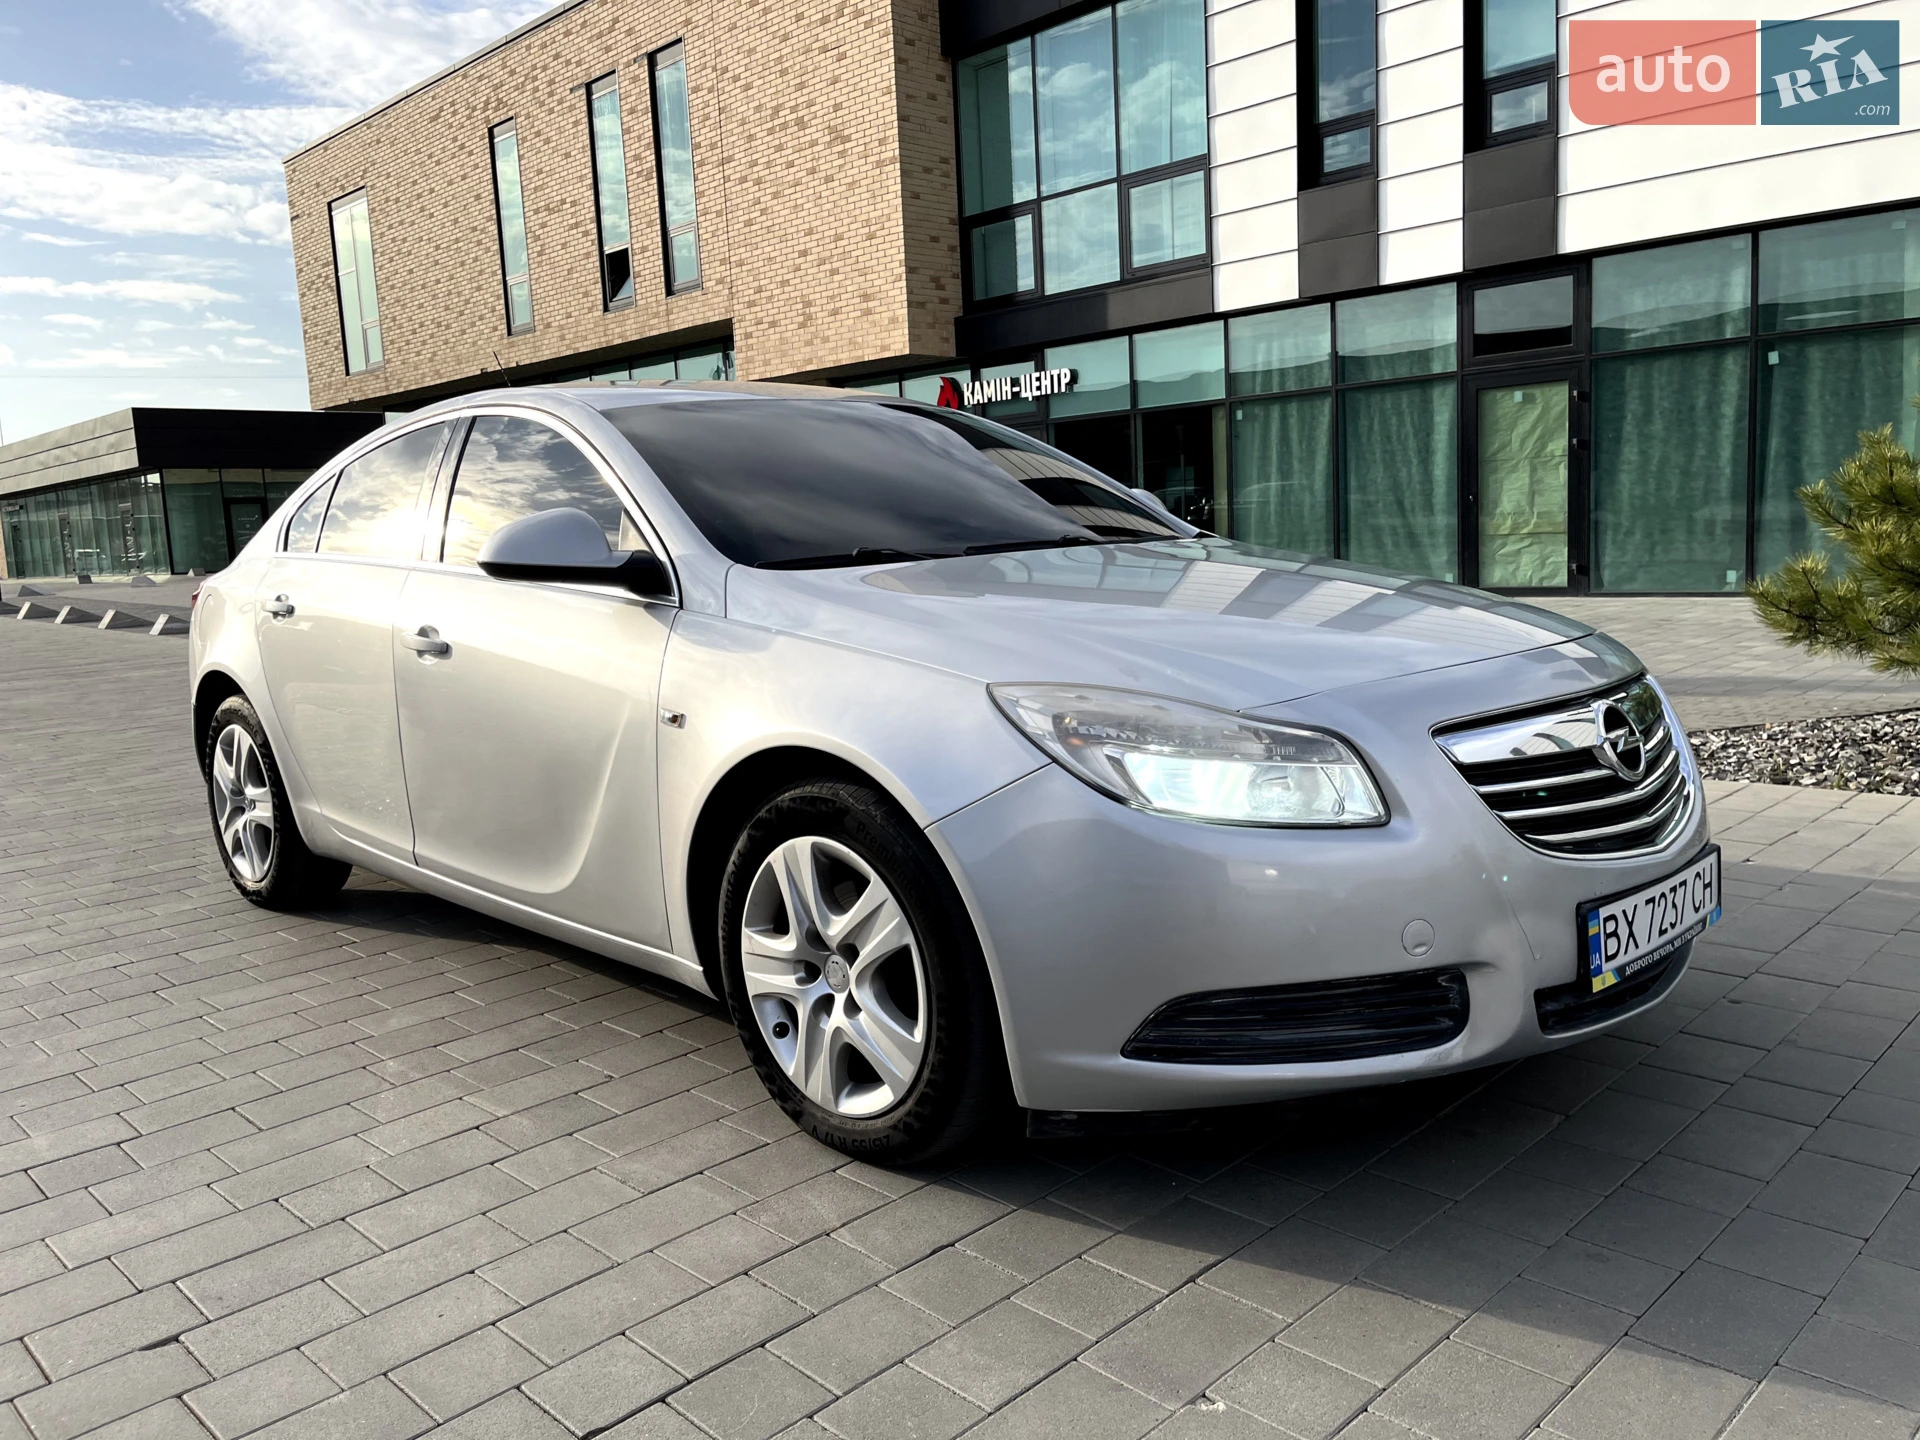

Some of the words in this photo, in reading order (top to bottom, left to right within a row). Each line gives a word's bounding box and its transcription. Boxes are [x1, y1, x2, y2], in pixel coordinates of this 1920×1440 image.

[963, 367, 1072, 406] КАМІН-ЦЕНТР
[1602, 903, 1640, 964] BX
[1644, 878, 1688, 945] 7237
[1691, 862, 1713, 914] CH
[1590, 953, 1601, 969] UA
[1625, 954, 1653, 977] ДОБРОГО
[1685, 922, 1703, 942] УКРА
